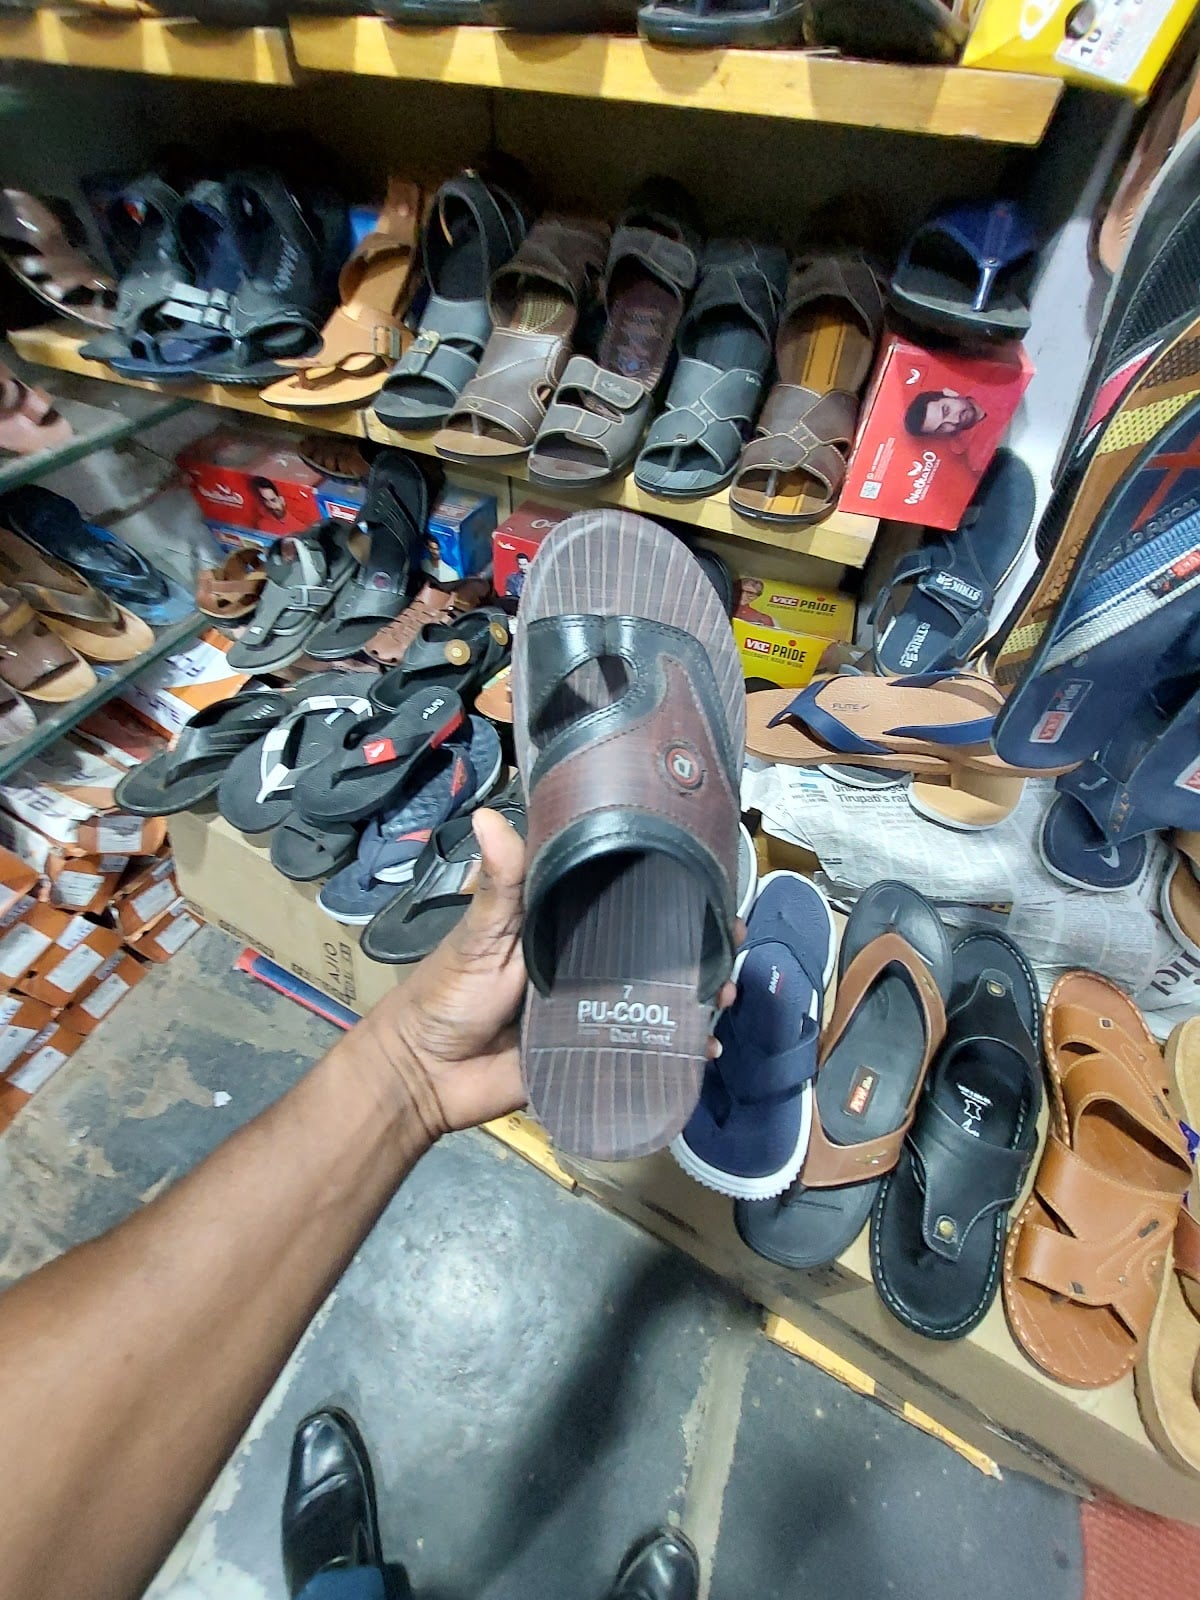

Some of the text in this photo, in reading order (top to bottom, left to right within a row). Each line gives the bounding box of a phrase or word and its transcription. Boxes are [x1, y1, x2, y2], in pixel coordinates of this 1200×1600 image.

[770, 595, 838, 613] VKC PRIDE
[744, 638, 771, 654] VKC
[771, 644, 807, 663] PRIDE
[623, 985, 633, 999] 7
[578, 1000, 678, 1026] PU-COOL
